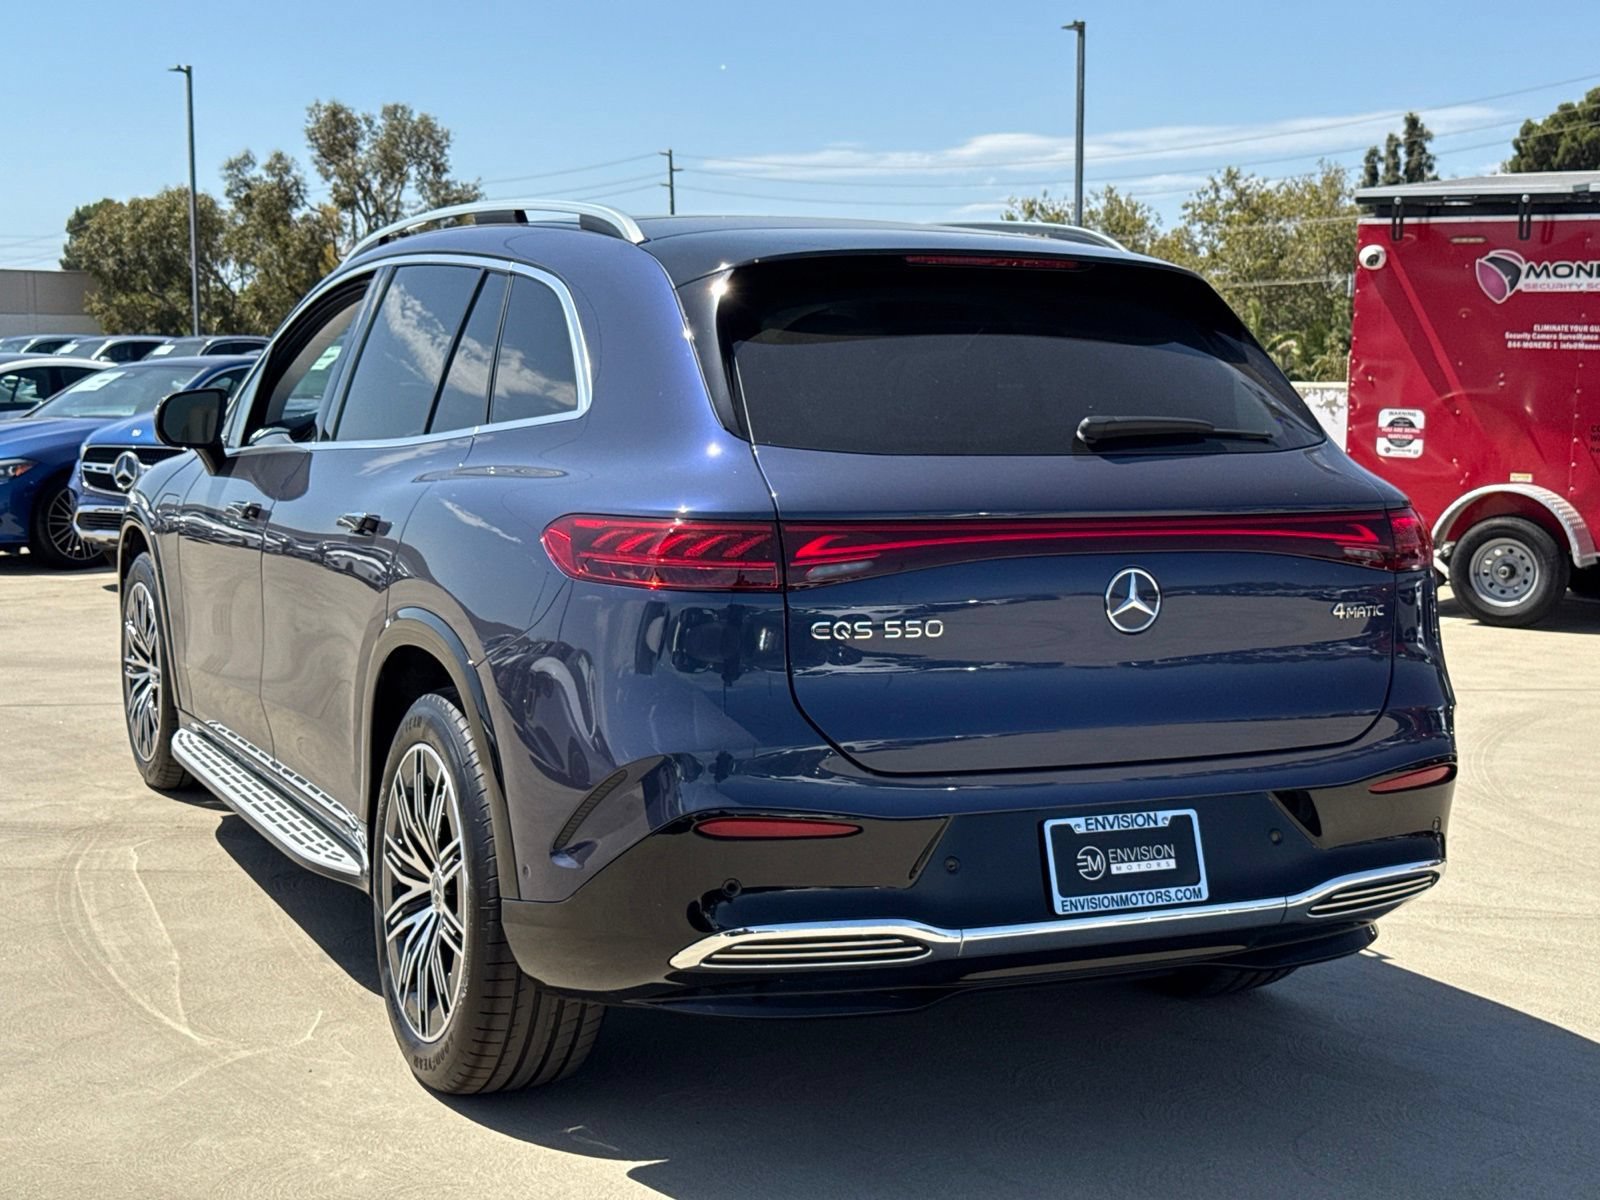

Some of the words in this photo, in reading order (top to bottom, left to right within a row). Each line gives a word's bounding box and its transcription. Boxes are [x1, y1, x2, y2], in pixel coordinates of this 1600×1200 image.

[1524, 263, 1600, 279] MON
[1524, 282, 1581, 290] SECURITY
[1533, 323, 1568, 332] ELIMINATE
[1504, 331, 1531, 341] Security
[1532, 332, 1557, 340] Camera
[1558, 332, 1599, 342] Surveillance
[1332, 602, 1385, 620] 4MATIC
[811, 620, 873, 641] EQS
[884, 619, 944, 639] 550
[1085, 813, 1158, 832] ENVISION
[1108, 844, 1175, 863] ENVISION
[1115, 862, 1172, 872] MOTORS
[1061, 887, 1203, 913] ENVISIONMOTORS.COM
